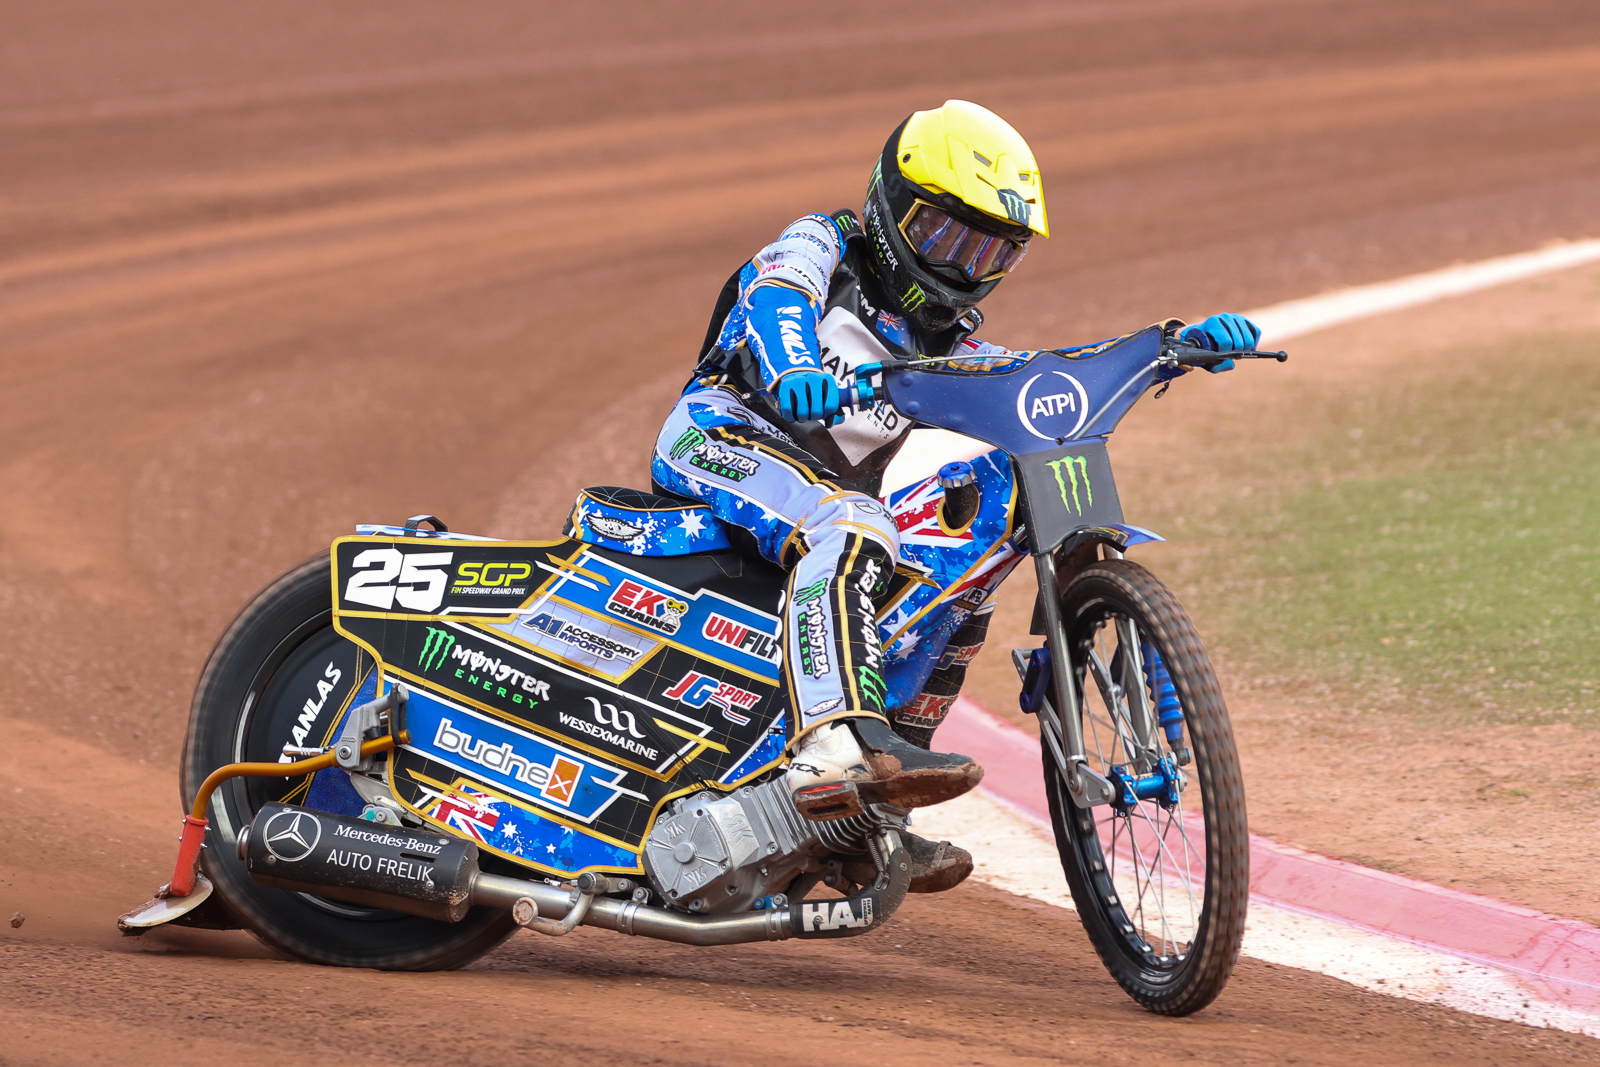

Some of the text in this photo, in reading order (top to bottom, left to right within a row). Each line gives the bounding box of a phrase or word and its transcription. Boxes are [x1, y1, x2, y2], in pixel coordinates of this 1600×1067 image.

[1030, 392, 1076, 419] ATPI
[691, 457, 746, 481] ENERGY
[344, 548, 454, 612] 25
[453, 562, 531, 587] SGP
[461, 587, 492, 595] SPEEDWAY
[492, 587, 511, 595] GRAND
[512, 588, 526, 596] PRIX
[613, 581, 667, 616] EK
[525, 613, 565, 637] A1
[607, 601, 677, 634] CHAINS
[559, 631, 615, 659] IMPORTS
[563, 625, 641, 659] ACCESSORY
[799, 613, 813, 675] ENERGY
[807, 597, 830, 680] MONSTER
[452, 645, 551, 701] MONSTER
[454, 669, 539, 709] ENERGY
[291, 661, 342, 748] ANLAS
[667, 673, 760, 708] JG SPORT
[906, 694, 950, 719] EK
[559, 712, 659, 762] WESSEXMARINE
[434, 718, 580, 802] budnex
[333, 824, 442, 855] Mercedes-Benz
[326, 849, 434, 883] AUTO FRELIK
